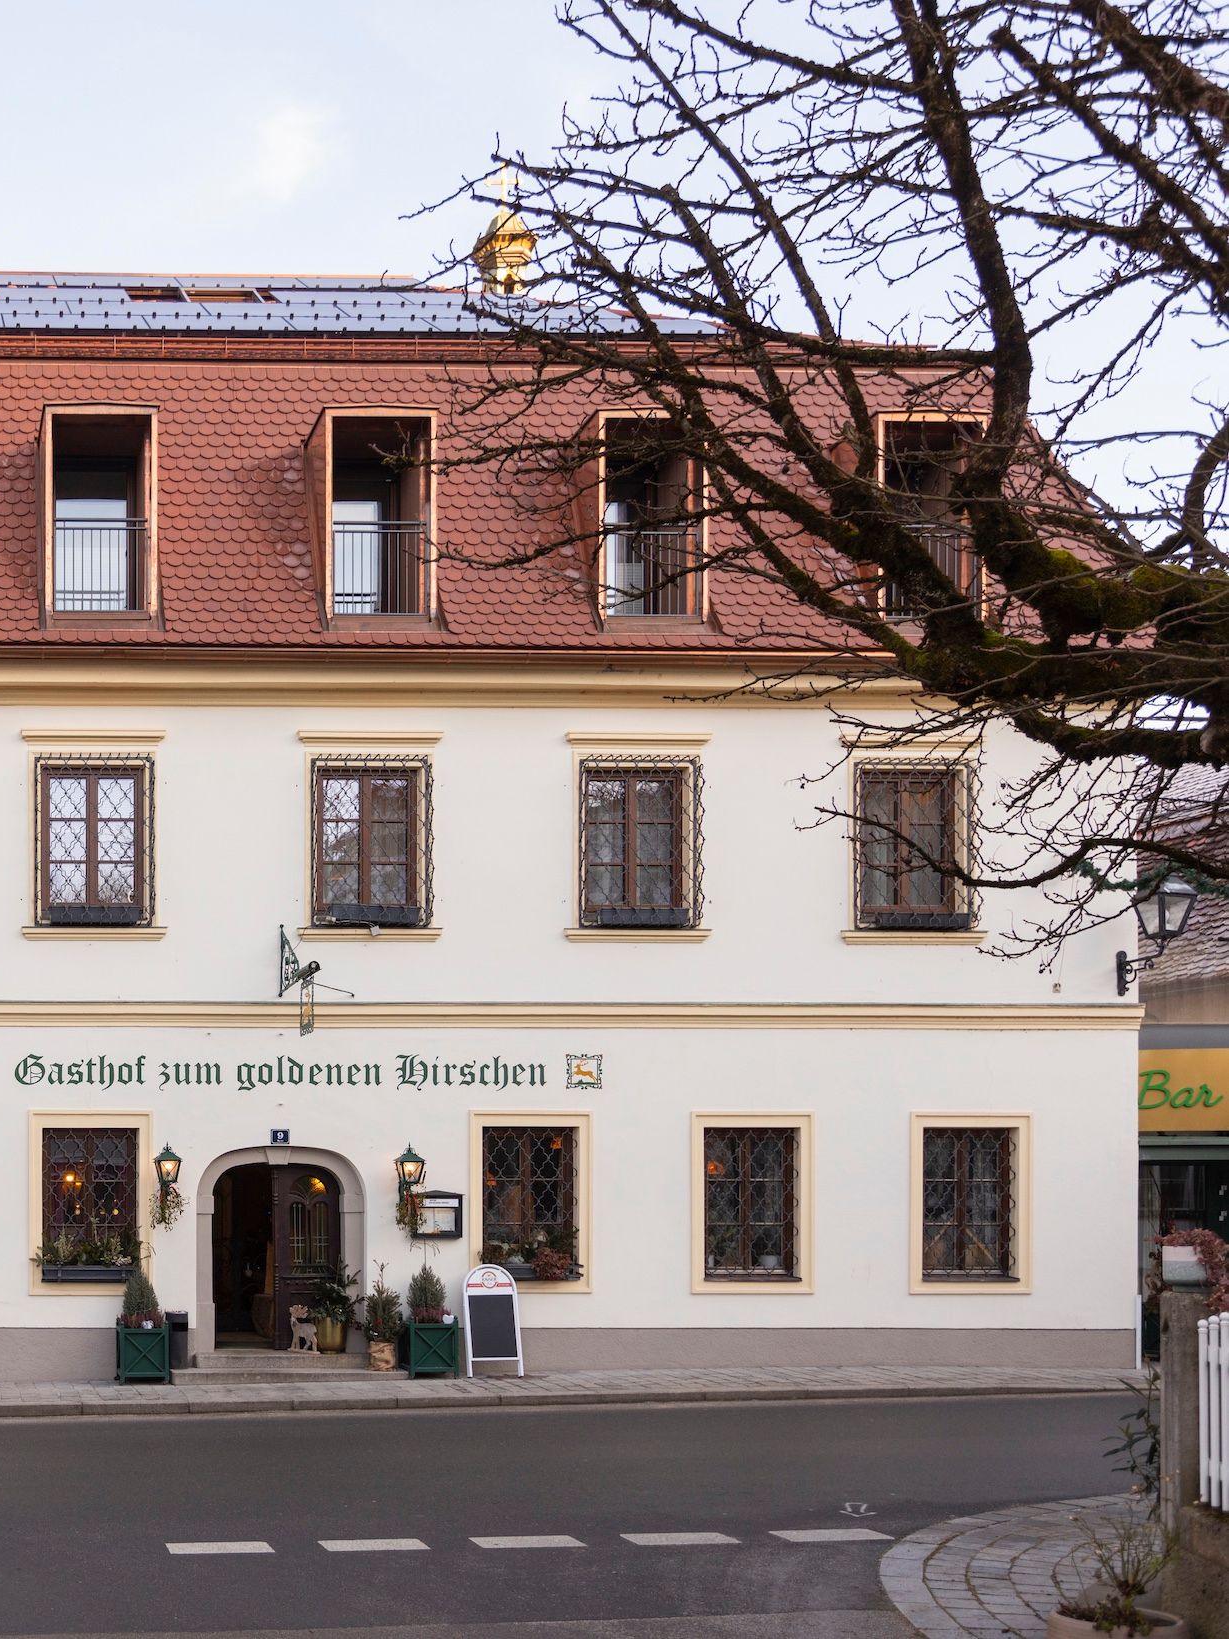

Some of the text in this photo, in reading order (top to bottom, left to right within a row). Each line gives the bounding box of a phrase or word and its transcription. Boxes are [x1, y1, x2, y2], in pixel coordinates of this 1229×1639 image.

[14, 1054, 547, 1092] Gasthof zum goldenen Hirschen
[1138, 1069, 1223, 1110] Bar
[277, 1131, 284, 1140] 9
